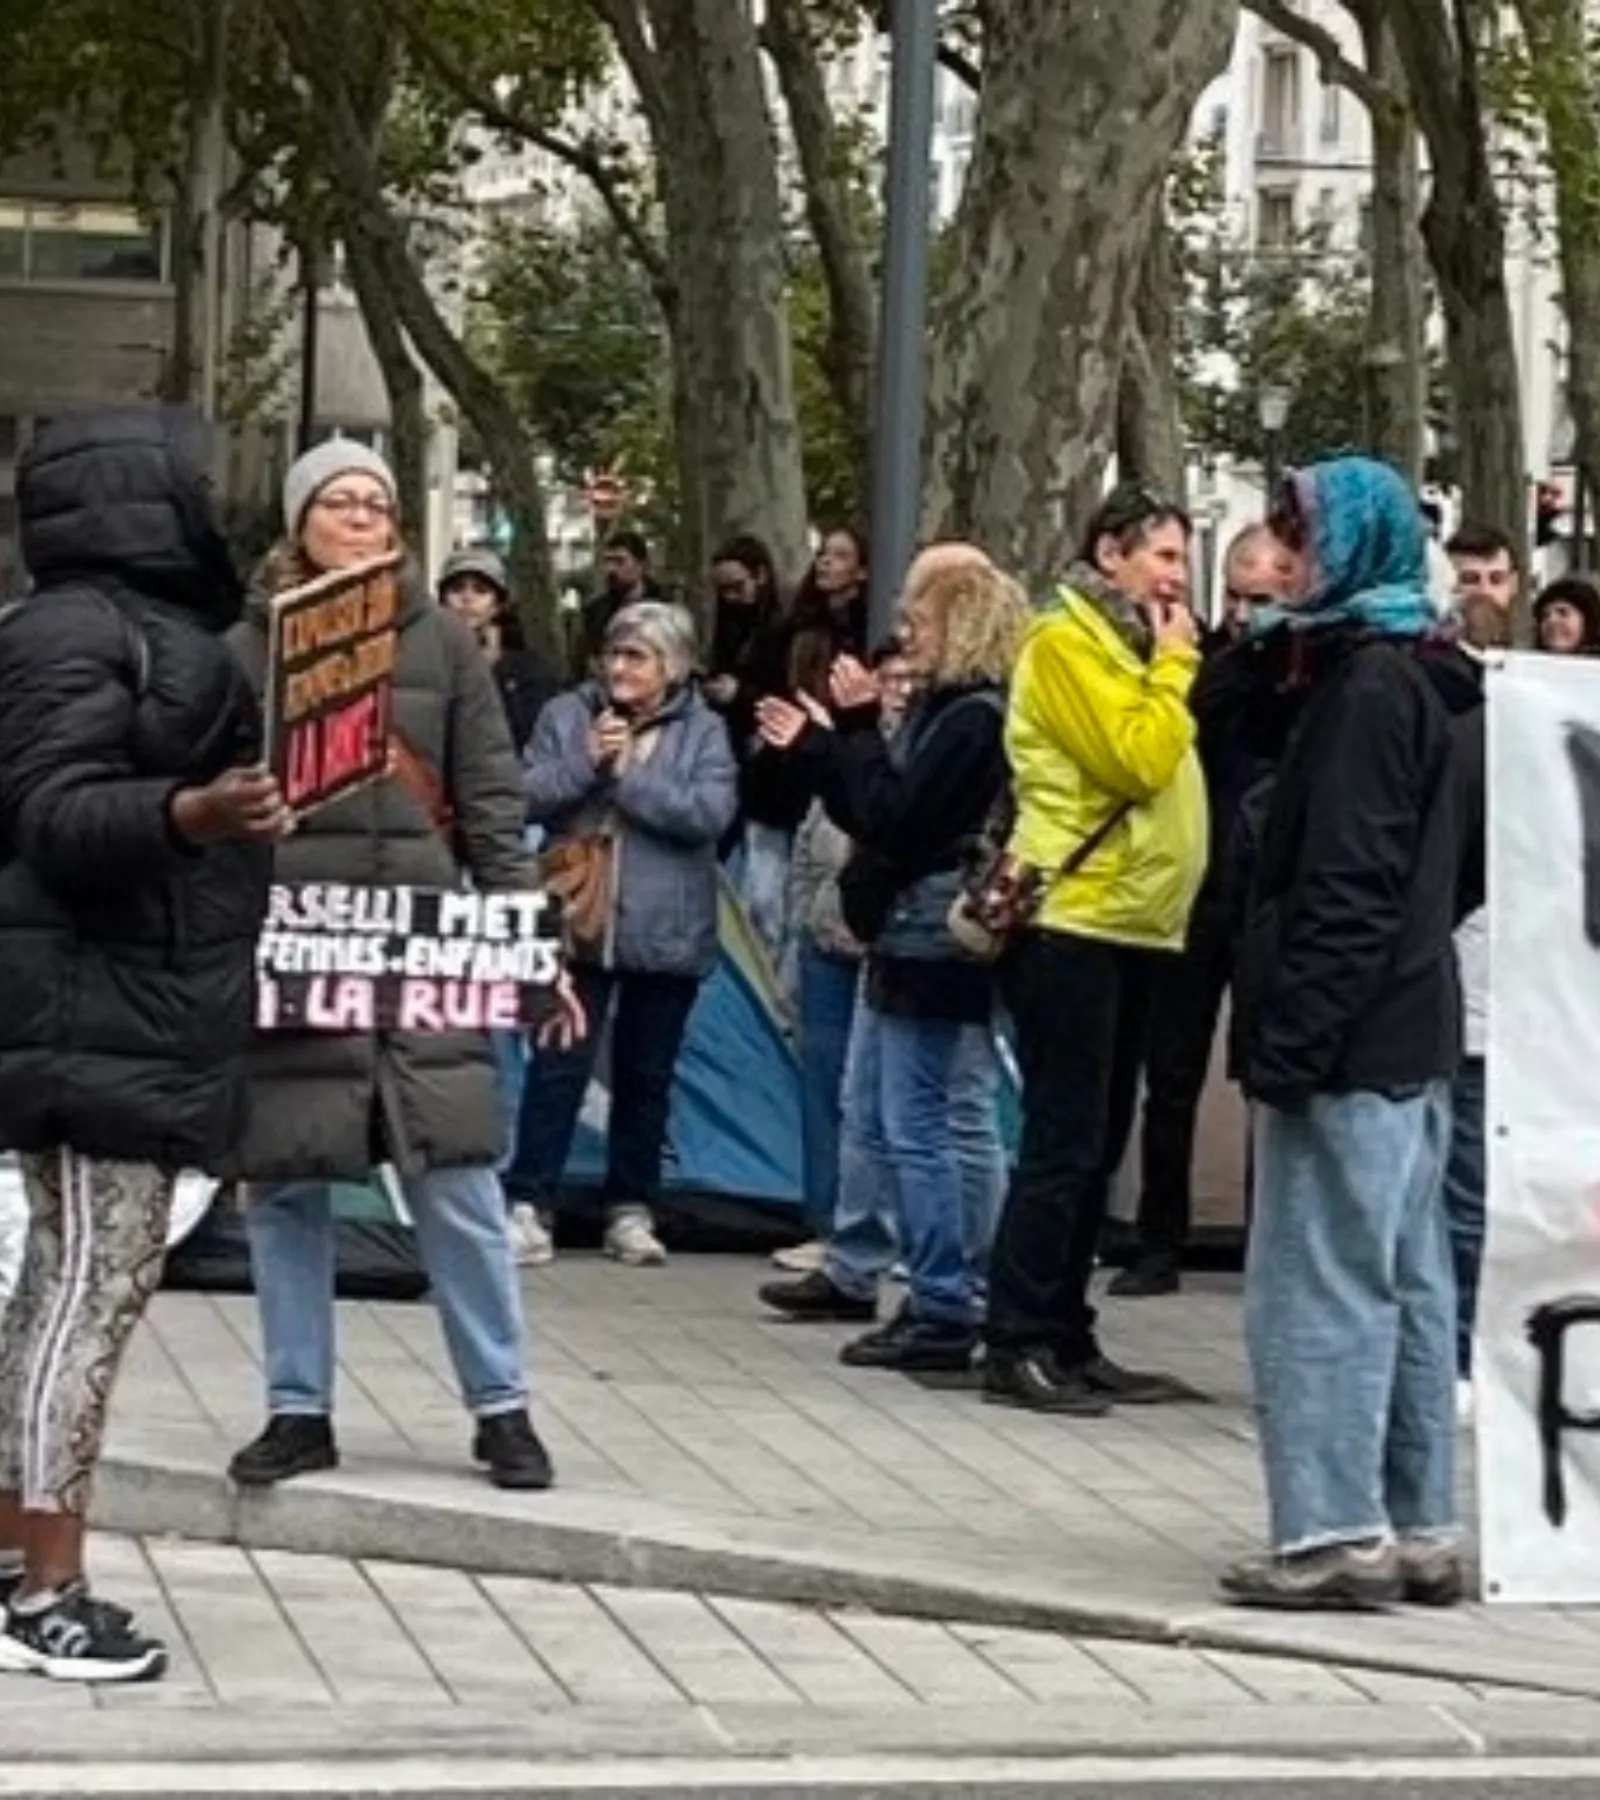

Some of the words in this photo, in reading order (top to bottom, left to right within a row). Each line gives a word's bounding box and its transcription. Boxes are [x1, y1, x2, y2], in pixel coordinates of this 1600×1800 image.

[437, 889, 548, 939] MET
[306, 977, 376, 1030] LA
[400, 979, 522, 1030] RUE
